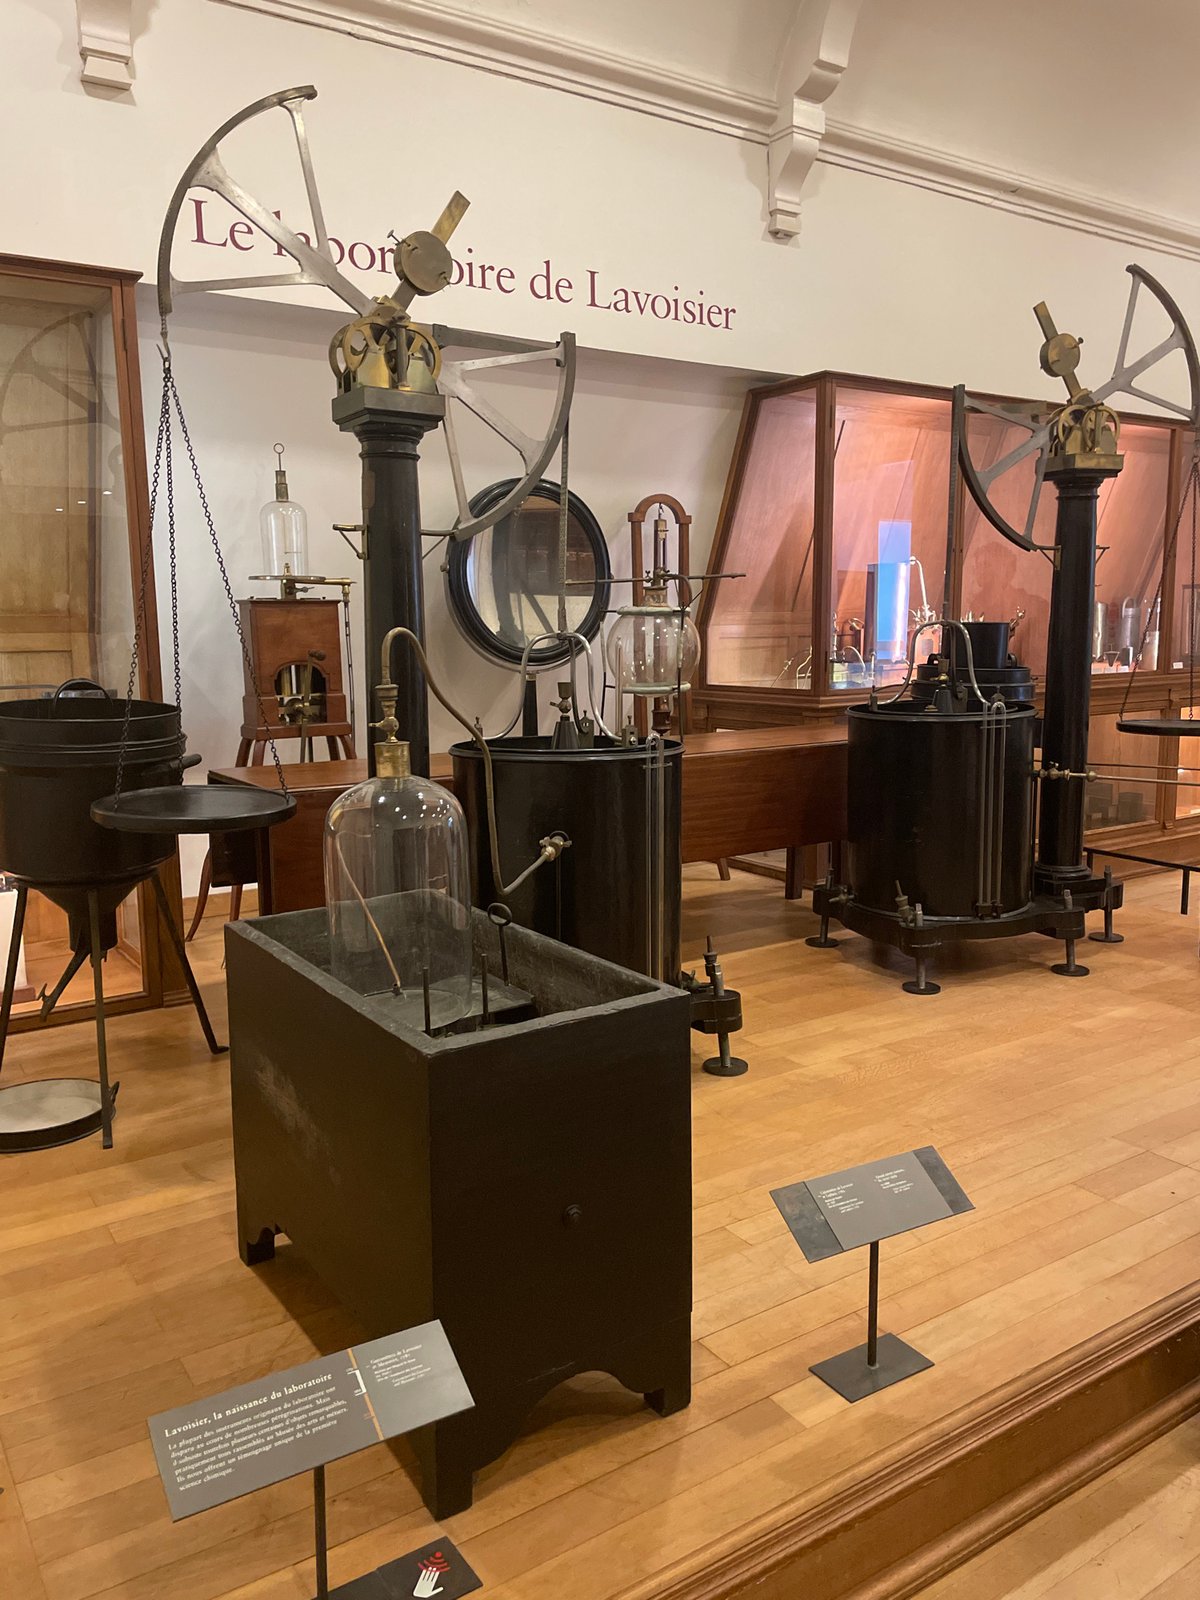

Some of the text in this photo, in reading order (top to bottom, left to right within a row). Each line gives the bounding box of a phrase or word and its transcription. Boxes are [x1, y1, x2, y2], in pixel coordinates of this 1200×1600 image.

[188, 198, 737, 331] Le oroire de Lavoisier
[164, 1374, 332, 1438] Lavoisier, la naissance du laboratoire
